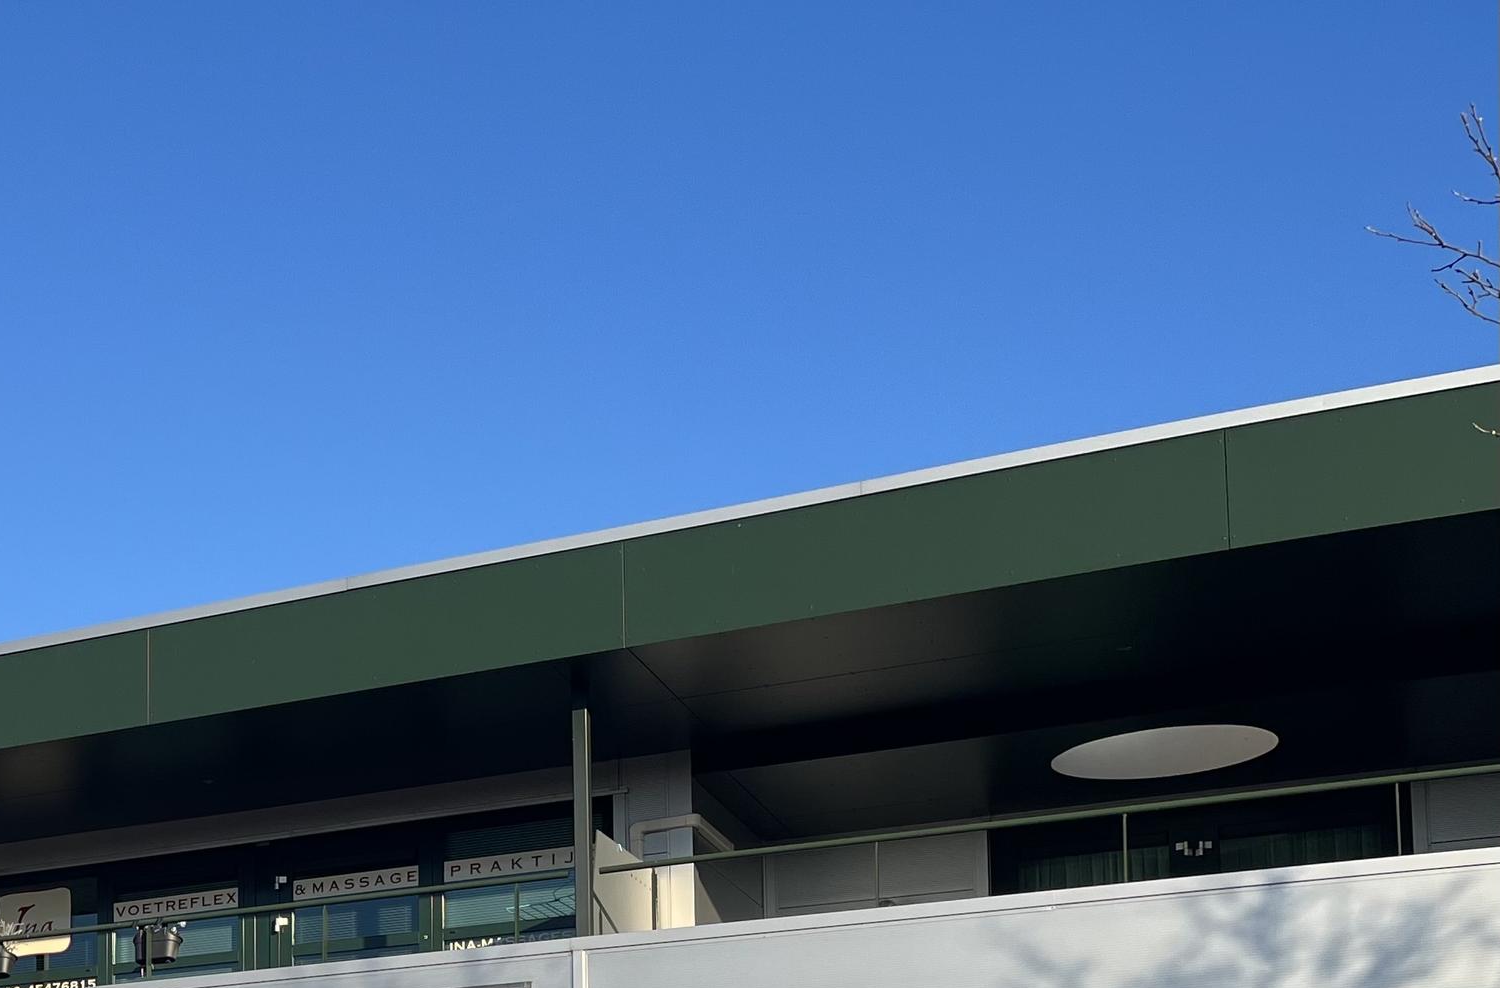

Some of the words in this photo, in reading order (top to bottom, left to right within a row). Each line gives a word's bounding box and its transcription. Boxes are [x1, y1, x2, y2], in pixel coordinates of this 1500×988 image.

[450, 851, 573, 877] PRAKTIJ
[295, 884, 306, 896] &
[312, 870, 418, 894] MASSAGE
[116, 890, 237, 918] VOETREFLEX
